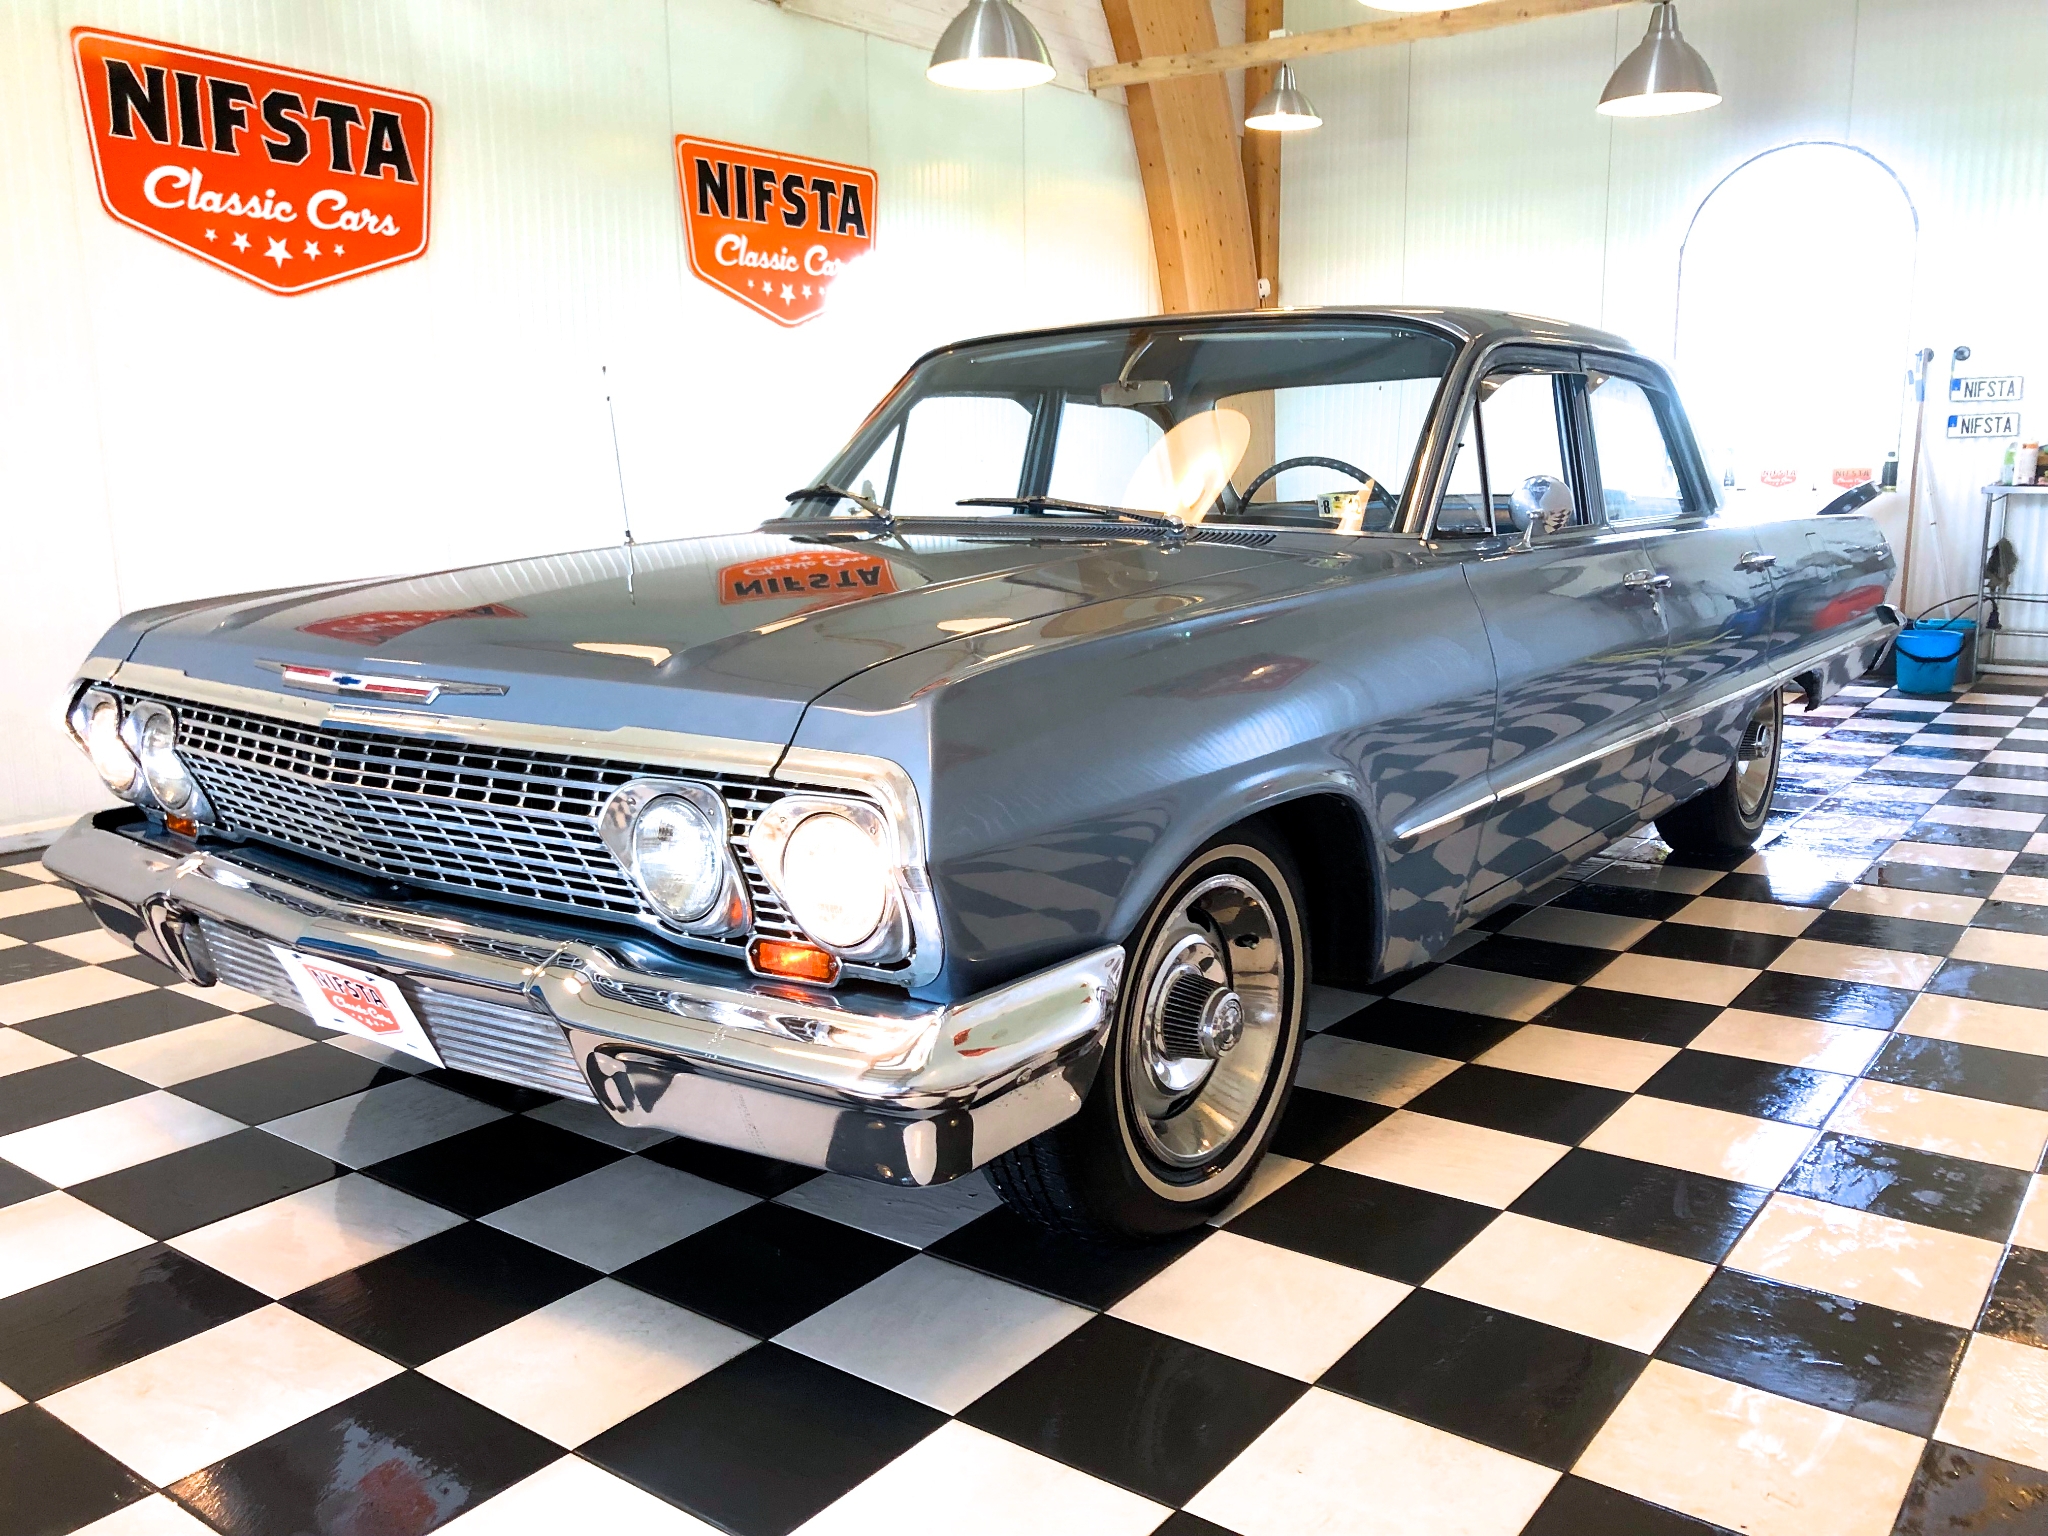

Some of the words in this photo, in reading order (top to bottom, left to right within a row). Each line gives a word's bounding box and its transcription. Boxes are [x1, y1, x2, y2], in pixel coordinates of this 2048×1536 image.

[102, 57, 419, 185] NIFSTA
[143, 165, 297, 223] Classic
[306, 189, 400, 237] Cars
[693, 156, 869, 238] NIFSTA
[715, 233, 799, 272] Classic
[1964, 380, 2015, 398] NIFSTA
[1961, 417, 2012, 434] NIFSTA
[311, 969, 387, 1009] NIFSTA
